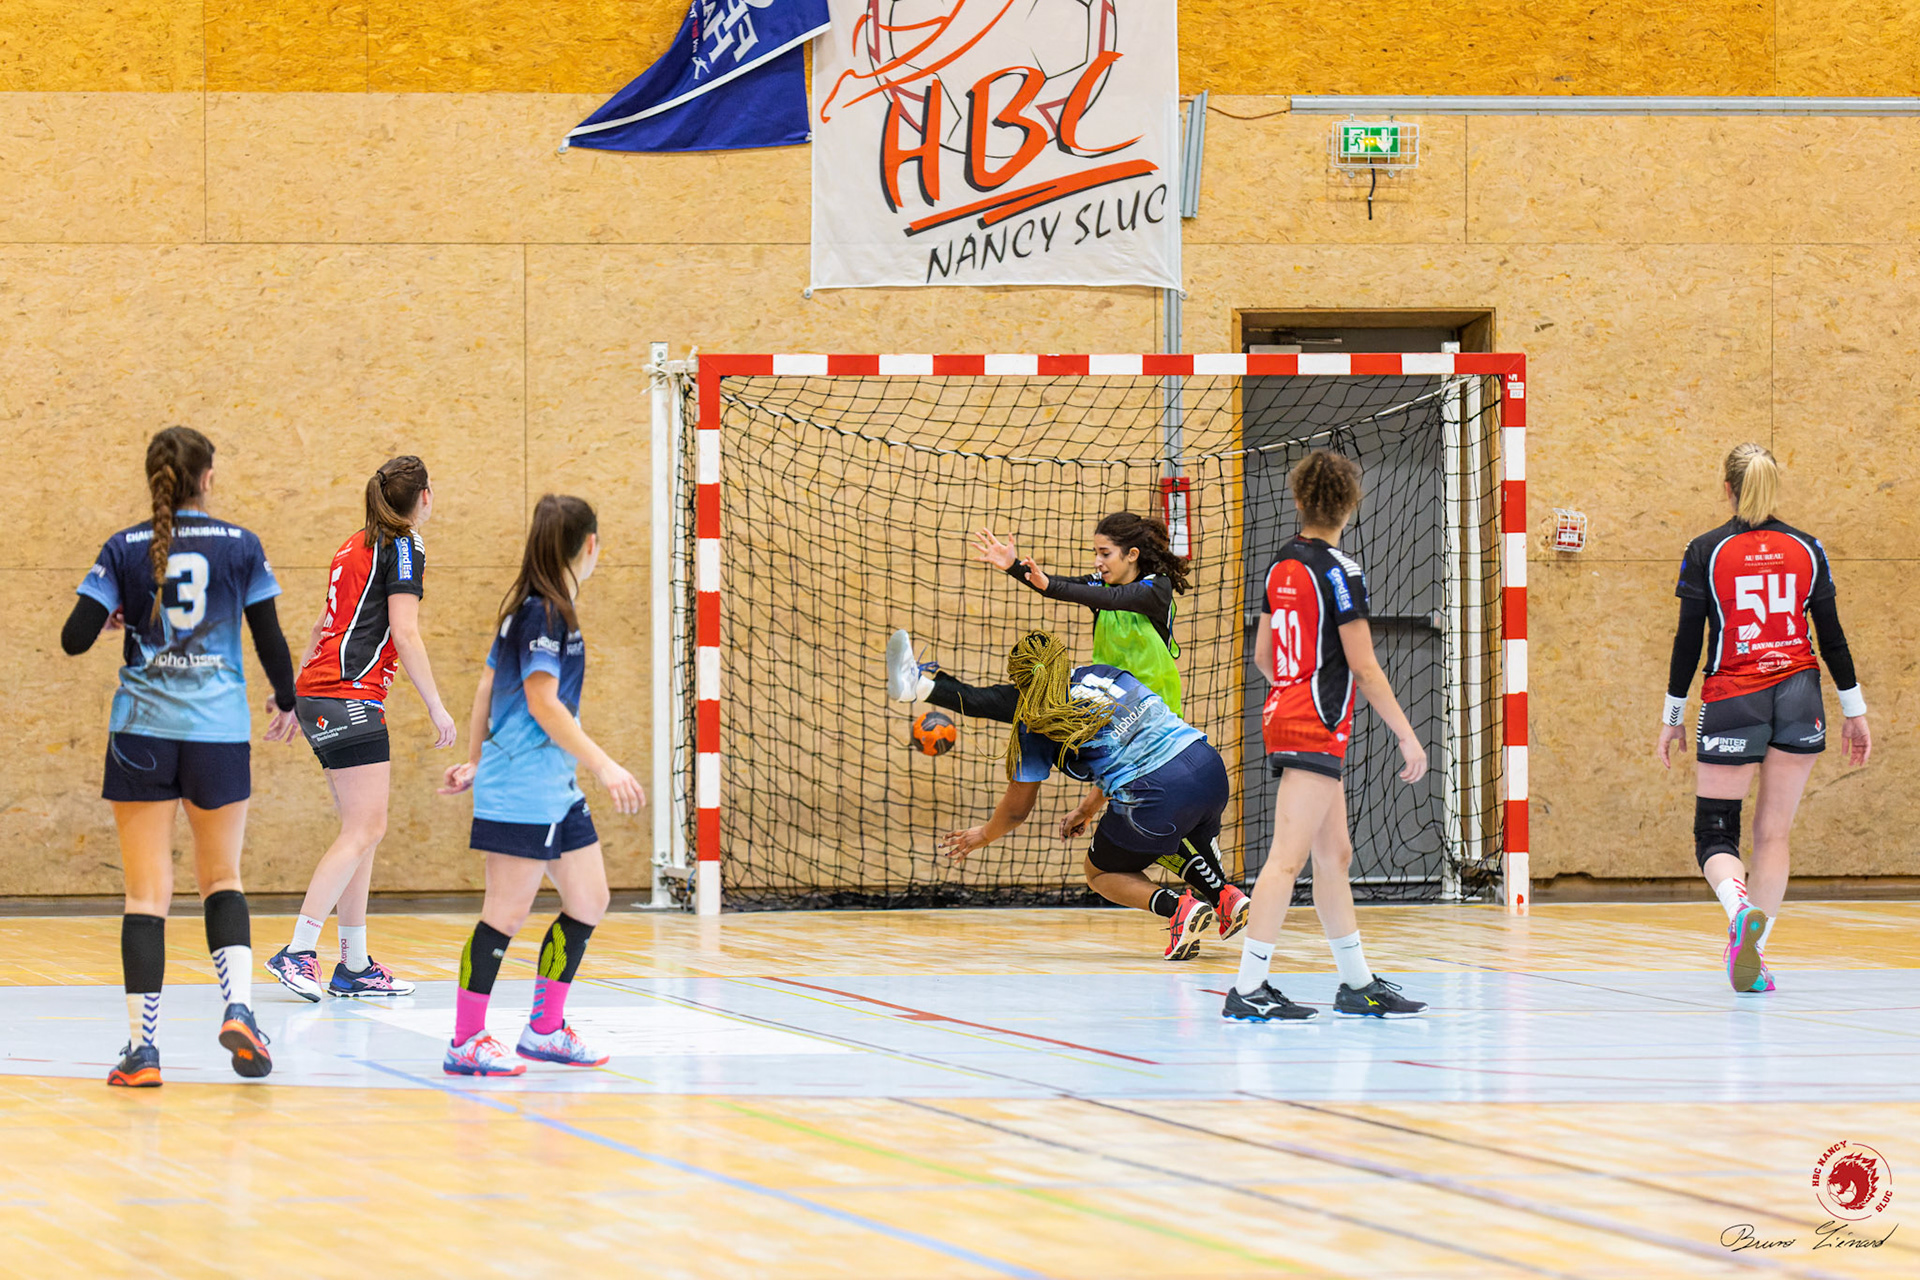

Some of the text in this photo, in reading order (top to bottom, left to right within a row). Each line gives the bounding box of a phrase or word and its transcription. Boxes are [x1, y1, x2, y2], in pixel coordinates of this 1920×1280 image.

[878, 50, 1145, 213] HBC
[926, 183, 1167, 284] NANCY SLUC
[399, 536, 412, 579] Grand Est
[165, 552, 210, 630] 3
[1331, 567, 1351, 610] Grand Est
[1734, 573, 1797, 641] 54
[1718, 745, 1745, 753] SPORT
[1719, 737, 1747, 746] INTER
